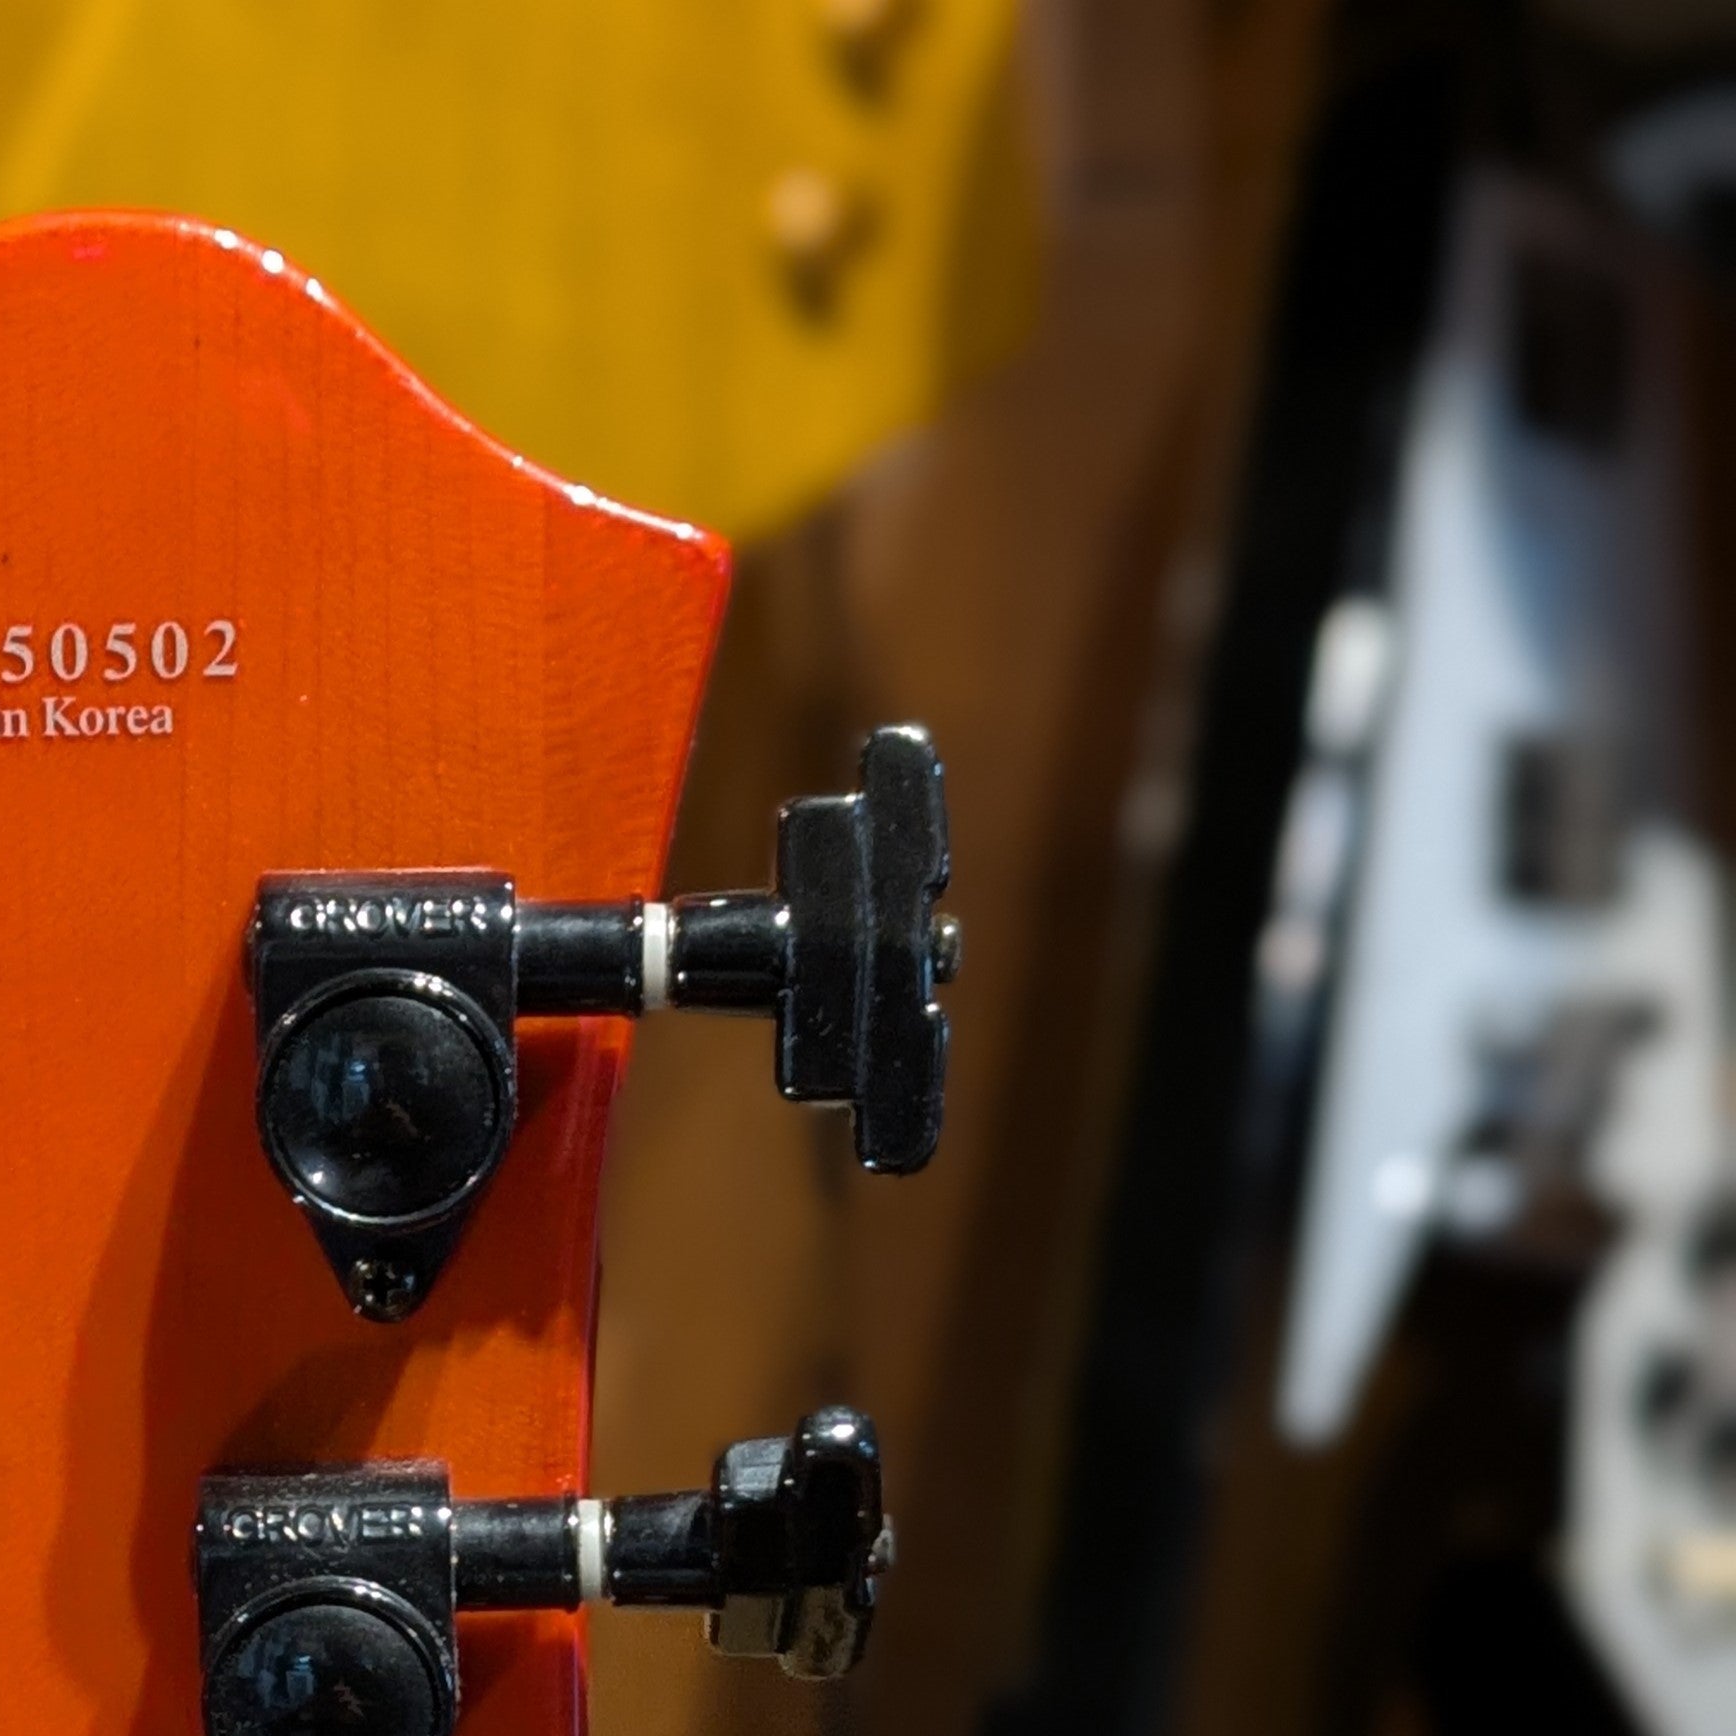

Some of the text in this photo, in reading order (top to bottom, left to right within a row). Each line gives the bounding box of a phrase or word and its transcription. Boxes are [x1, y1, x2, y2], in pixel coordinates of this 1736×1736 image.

[43, 696, 174, 737] Korea
[284, 894, 488, 936] GROVER
[225, 1504, 425, 1548] GROVER
